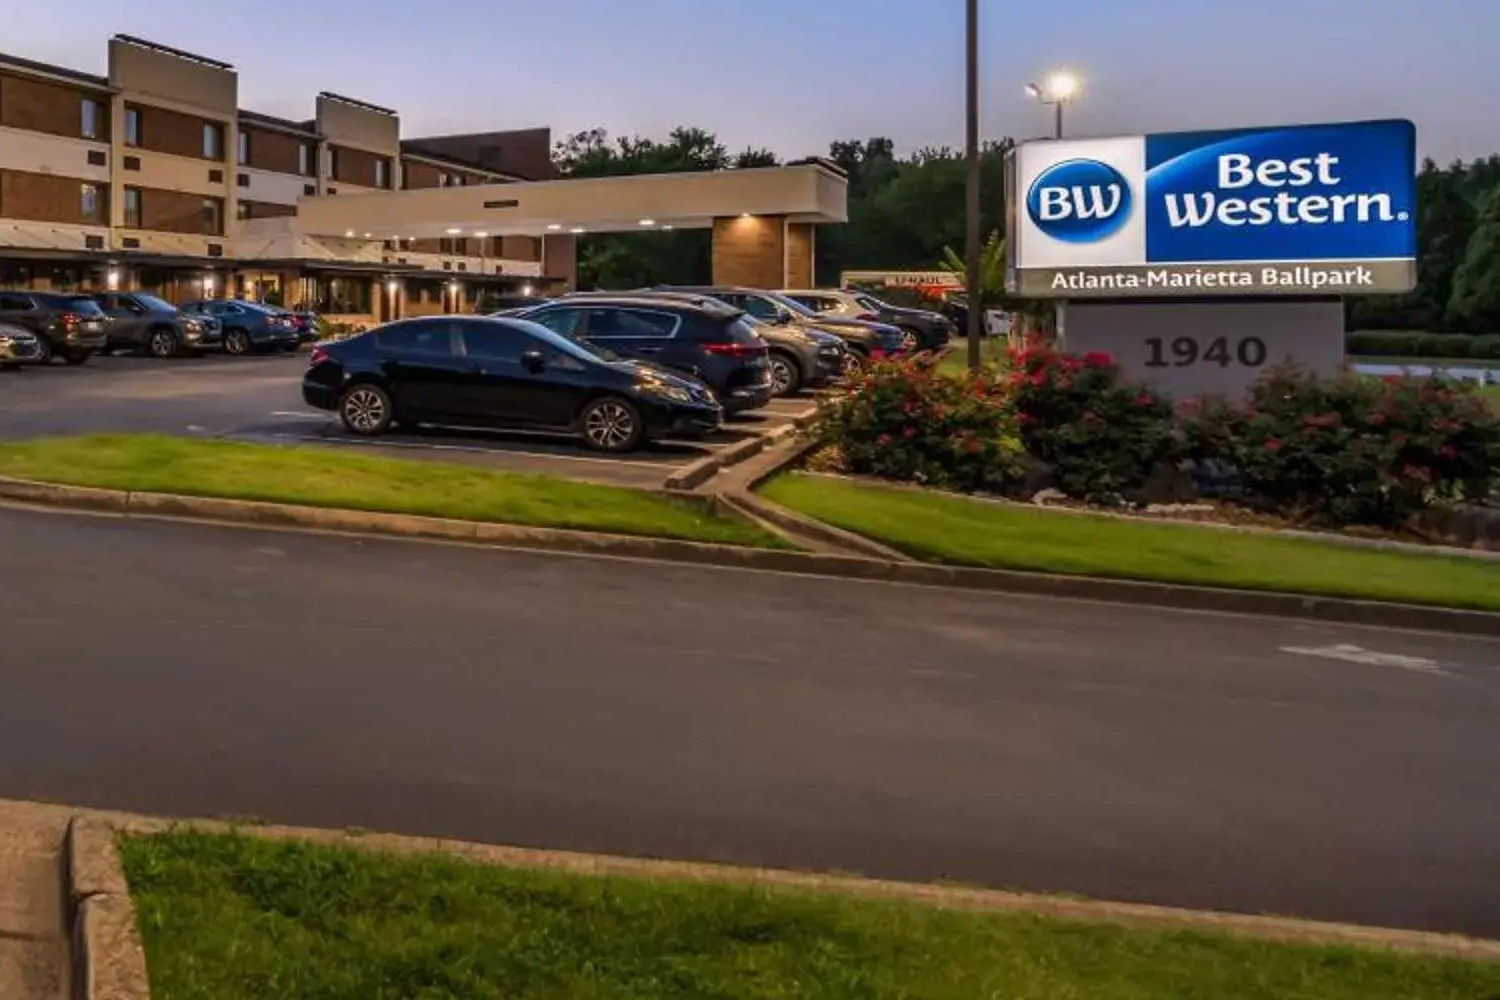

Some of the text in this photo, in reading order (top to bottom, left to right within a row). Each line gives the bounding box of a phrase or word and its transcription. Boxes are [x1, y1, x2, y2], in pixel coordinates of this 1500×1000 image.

[1217, 152, 1340, 188] Best
[1038, 183, 1123, 221] BW
[1051, 267, 1374, 290] Atlanta-Marietta Ballpark
[1143, 336, 1268, 368] 1940
